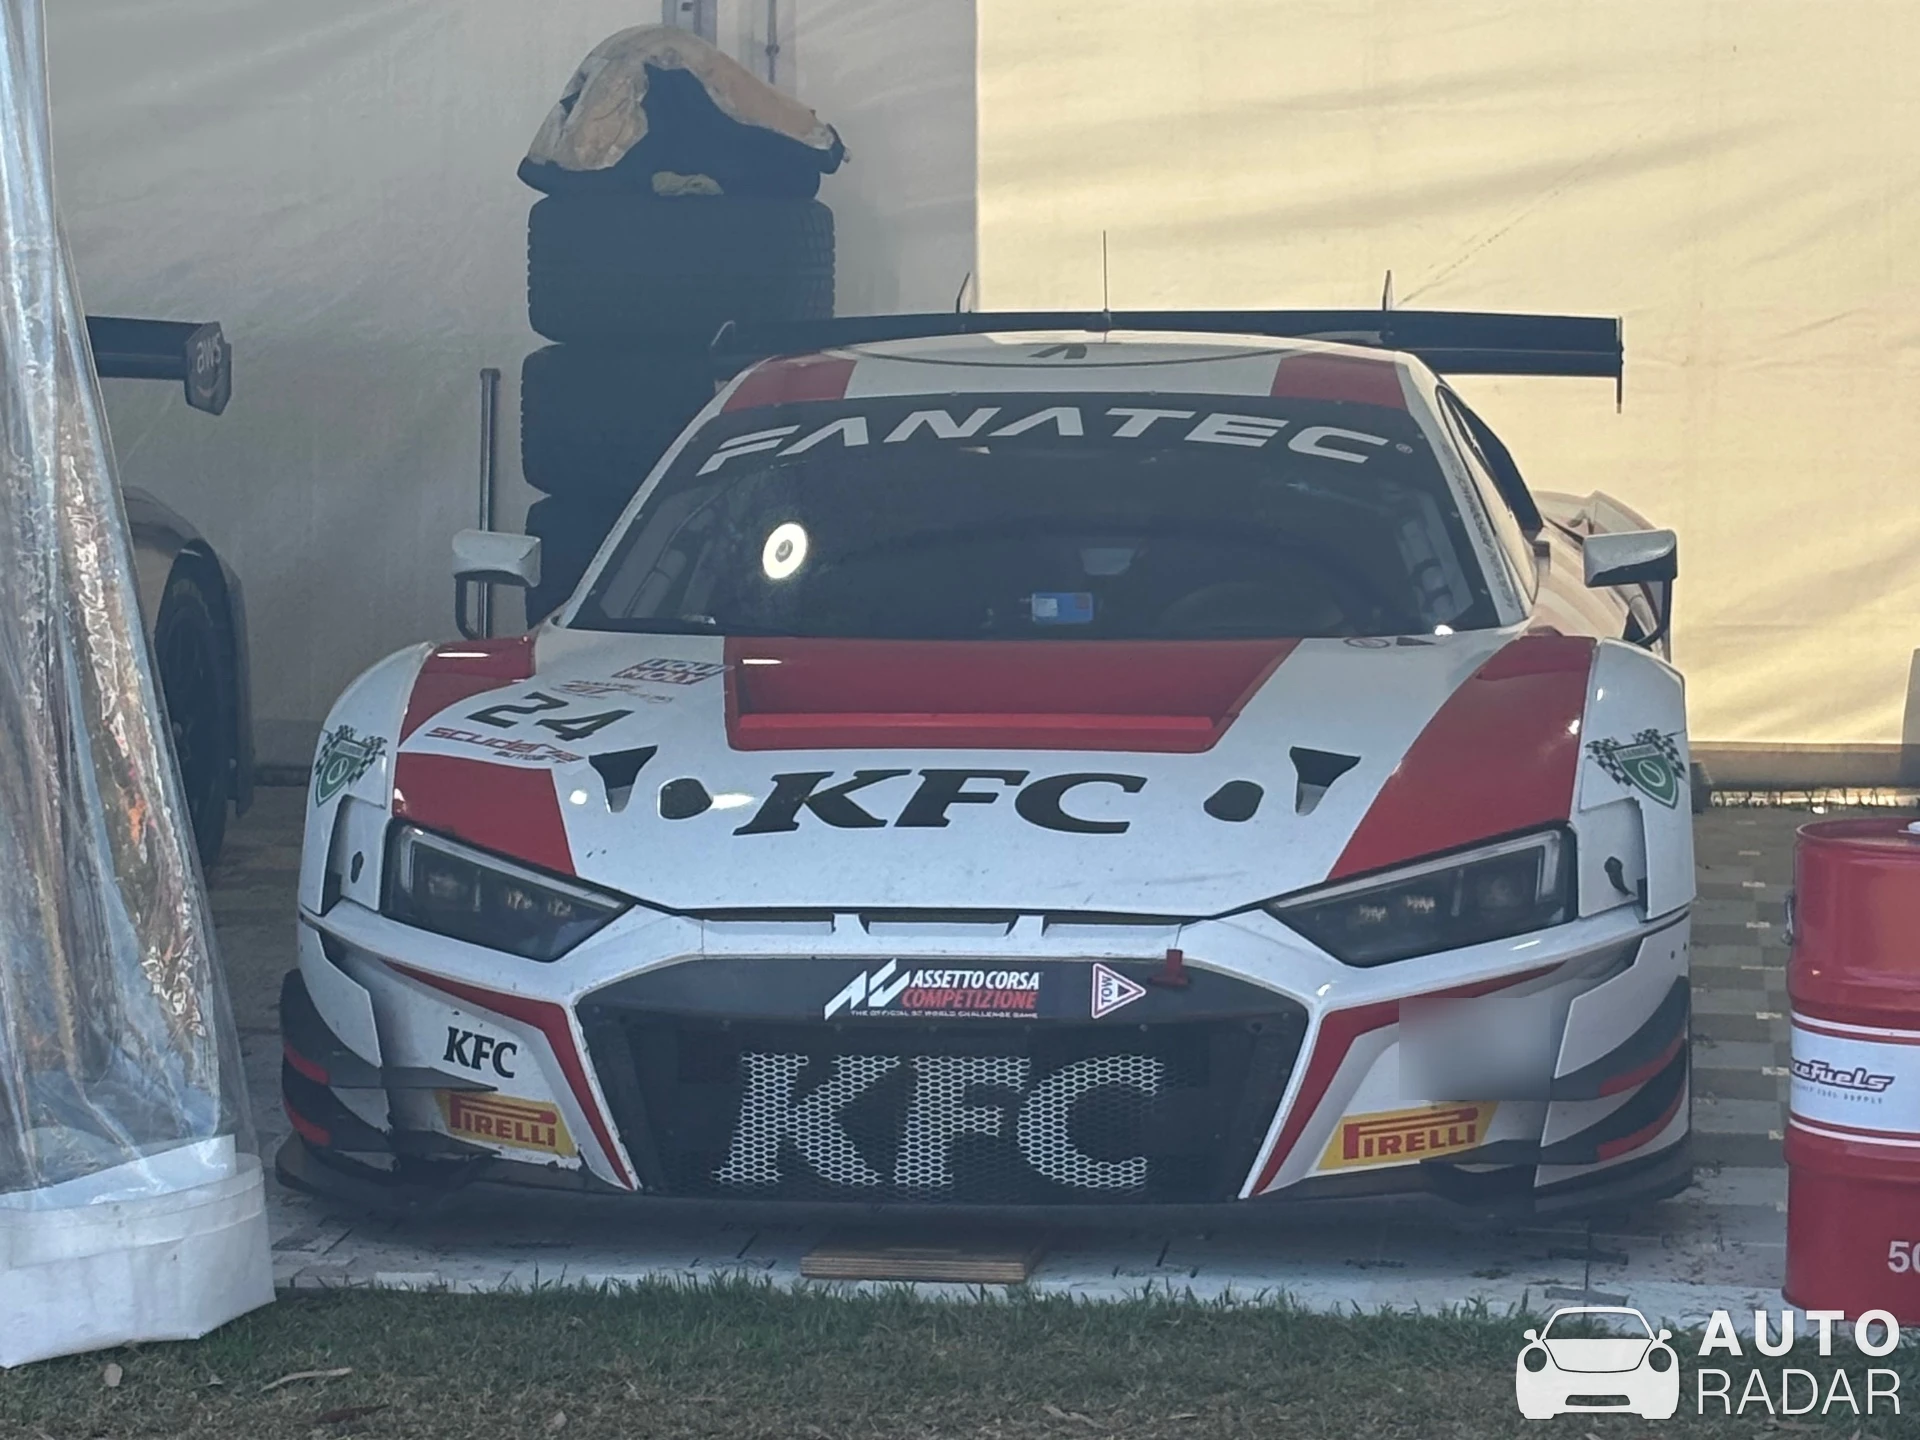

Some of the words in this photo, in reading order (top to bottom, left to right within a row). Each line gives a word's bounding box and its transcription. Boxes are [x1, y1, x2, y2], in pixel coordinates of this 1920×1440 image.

[696, 406, 1389, 477] FANATEC
[618, 667, 705, 684] MOLY
[643, 658, 735, 674] LIQUI
[464, 691, 635, 742] 24
[732, 768, 1148, 836] KFC
[902, 987, 1039, 1010] COMPETIZIONE
[909, 969, 984, 989] ASSETTO
[984, 970, 1040, 990] CORSA
[1101, 974, 1113, 1006] TOW
[443, 1026, 517, 1079] KFC
[449, 1092, 557, 1148] PIRELLI
[710, 1052, 1165, 1189] KFC
[1343, 1106, 1479, 1160] PIRELLI
